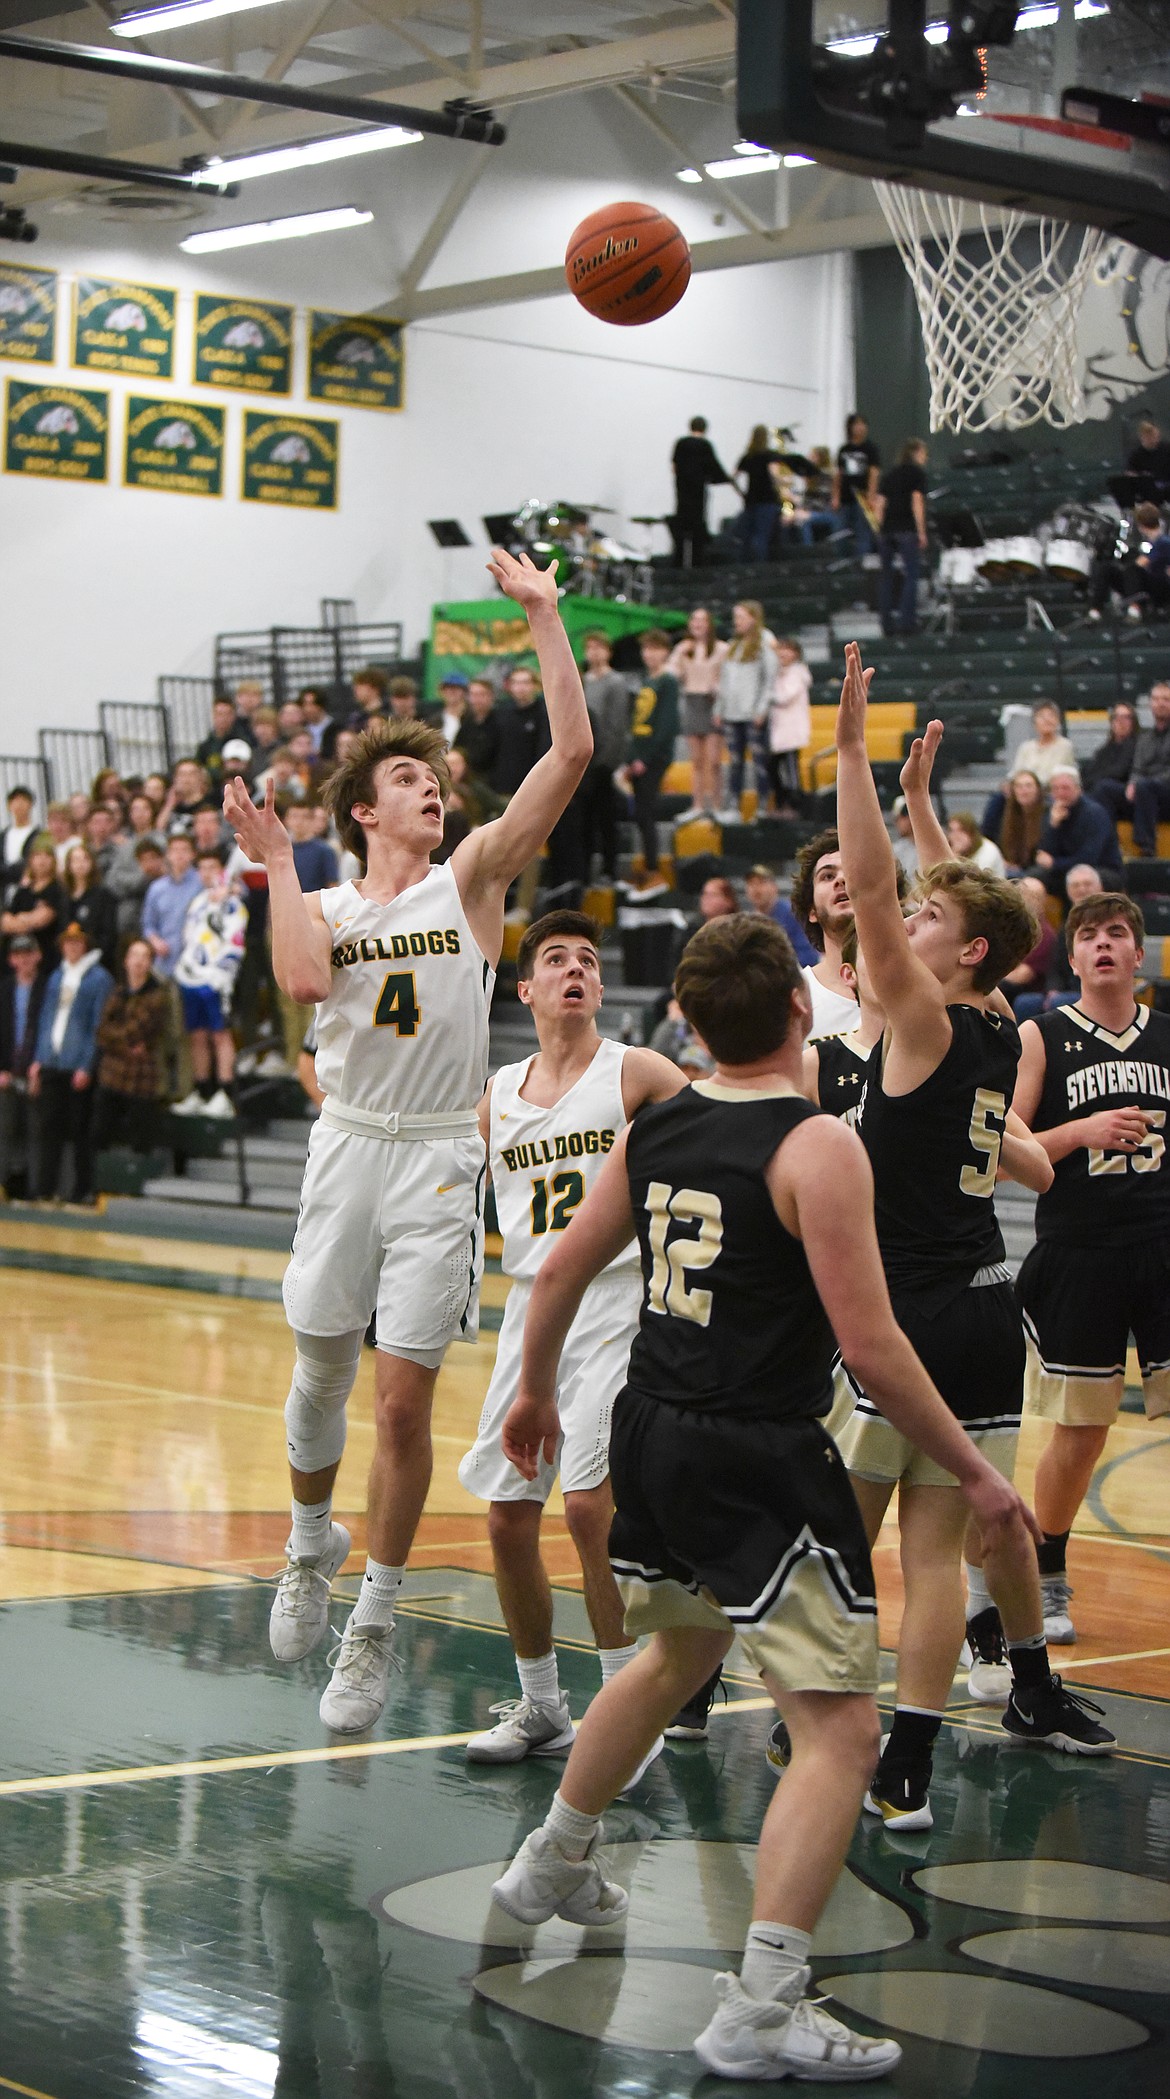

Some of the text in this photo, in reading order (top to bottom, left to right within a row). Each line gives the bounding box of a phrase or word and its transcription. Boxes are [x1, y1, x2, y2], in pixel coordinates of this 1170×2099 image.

[573, 236, 638, 284] Baden
[332, 929, 461, 969] BULLDOGS
[373, 970, 421, 1038] 4
[500, 1129, 615, 1172] BULLDOGS
[959, 1087, 1006, 1198] 5
[530, 1169, 585, 1237] 12
[644, 1181, 724, 1328] 12
